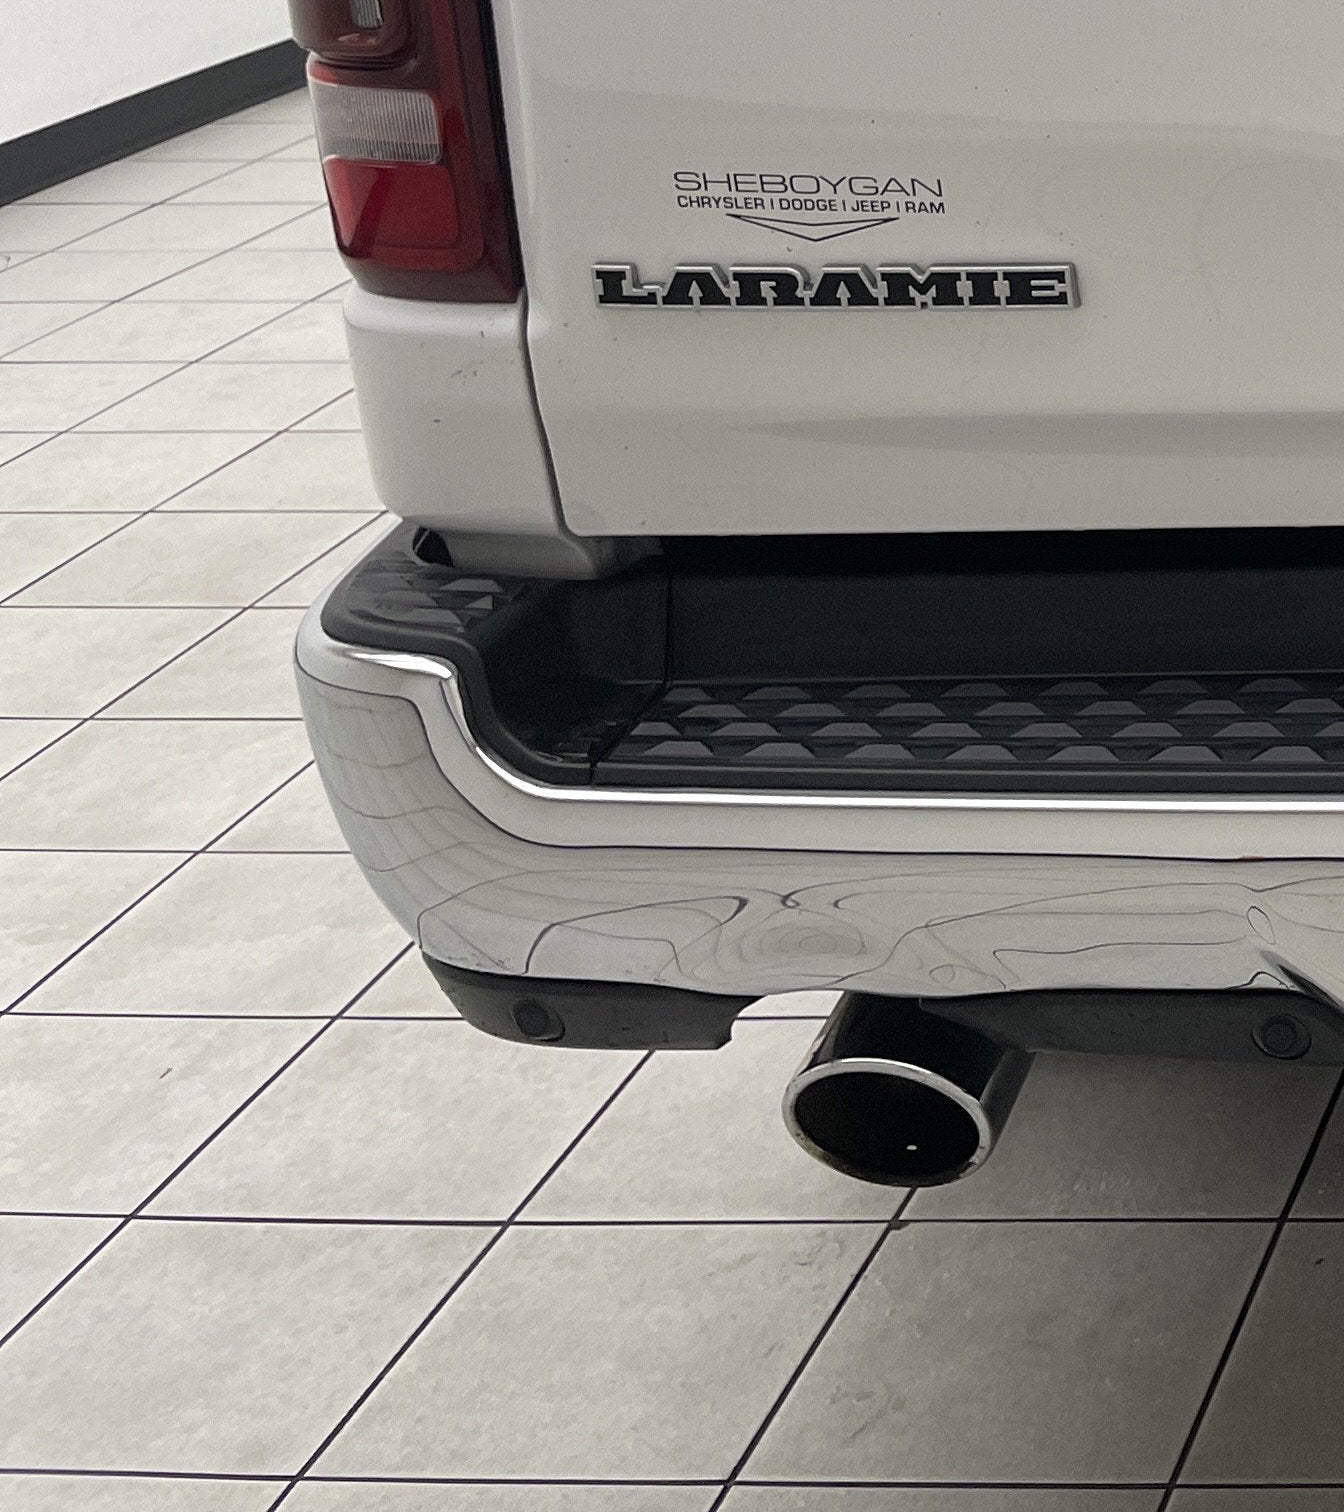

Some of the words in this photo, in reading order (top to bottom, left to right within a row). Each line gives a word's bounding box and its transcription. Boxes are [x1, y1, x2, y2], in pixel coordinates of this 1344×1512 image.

[673, 171, 944, 198] SHEBOYGAN
[677, 195, 765, 210] CHRYSLER
[779, 197, 838, 211] DODGE
[851, 199, 892, 213] JEEP
[905, 201, 946, 215] RAM
[591, 262, 1081, 310] LARAMIE
